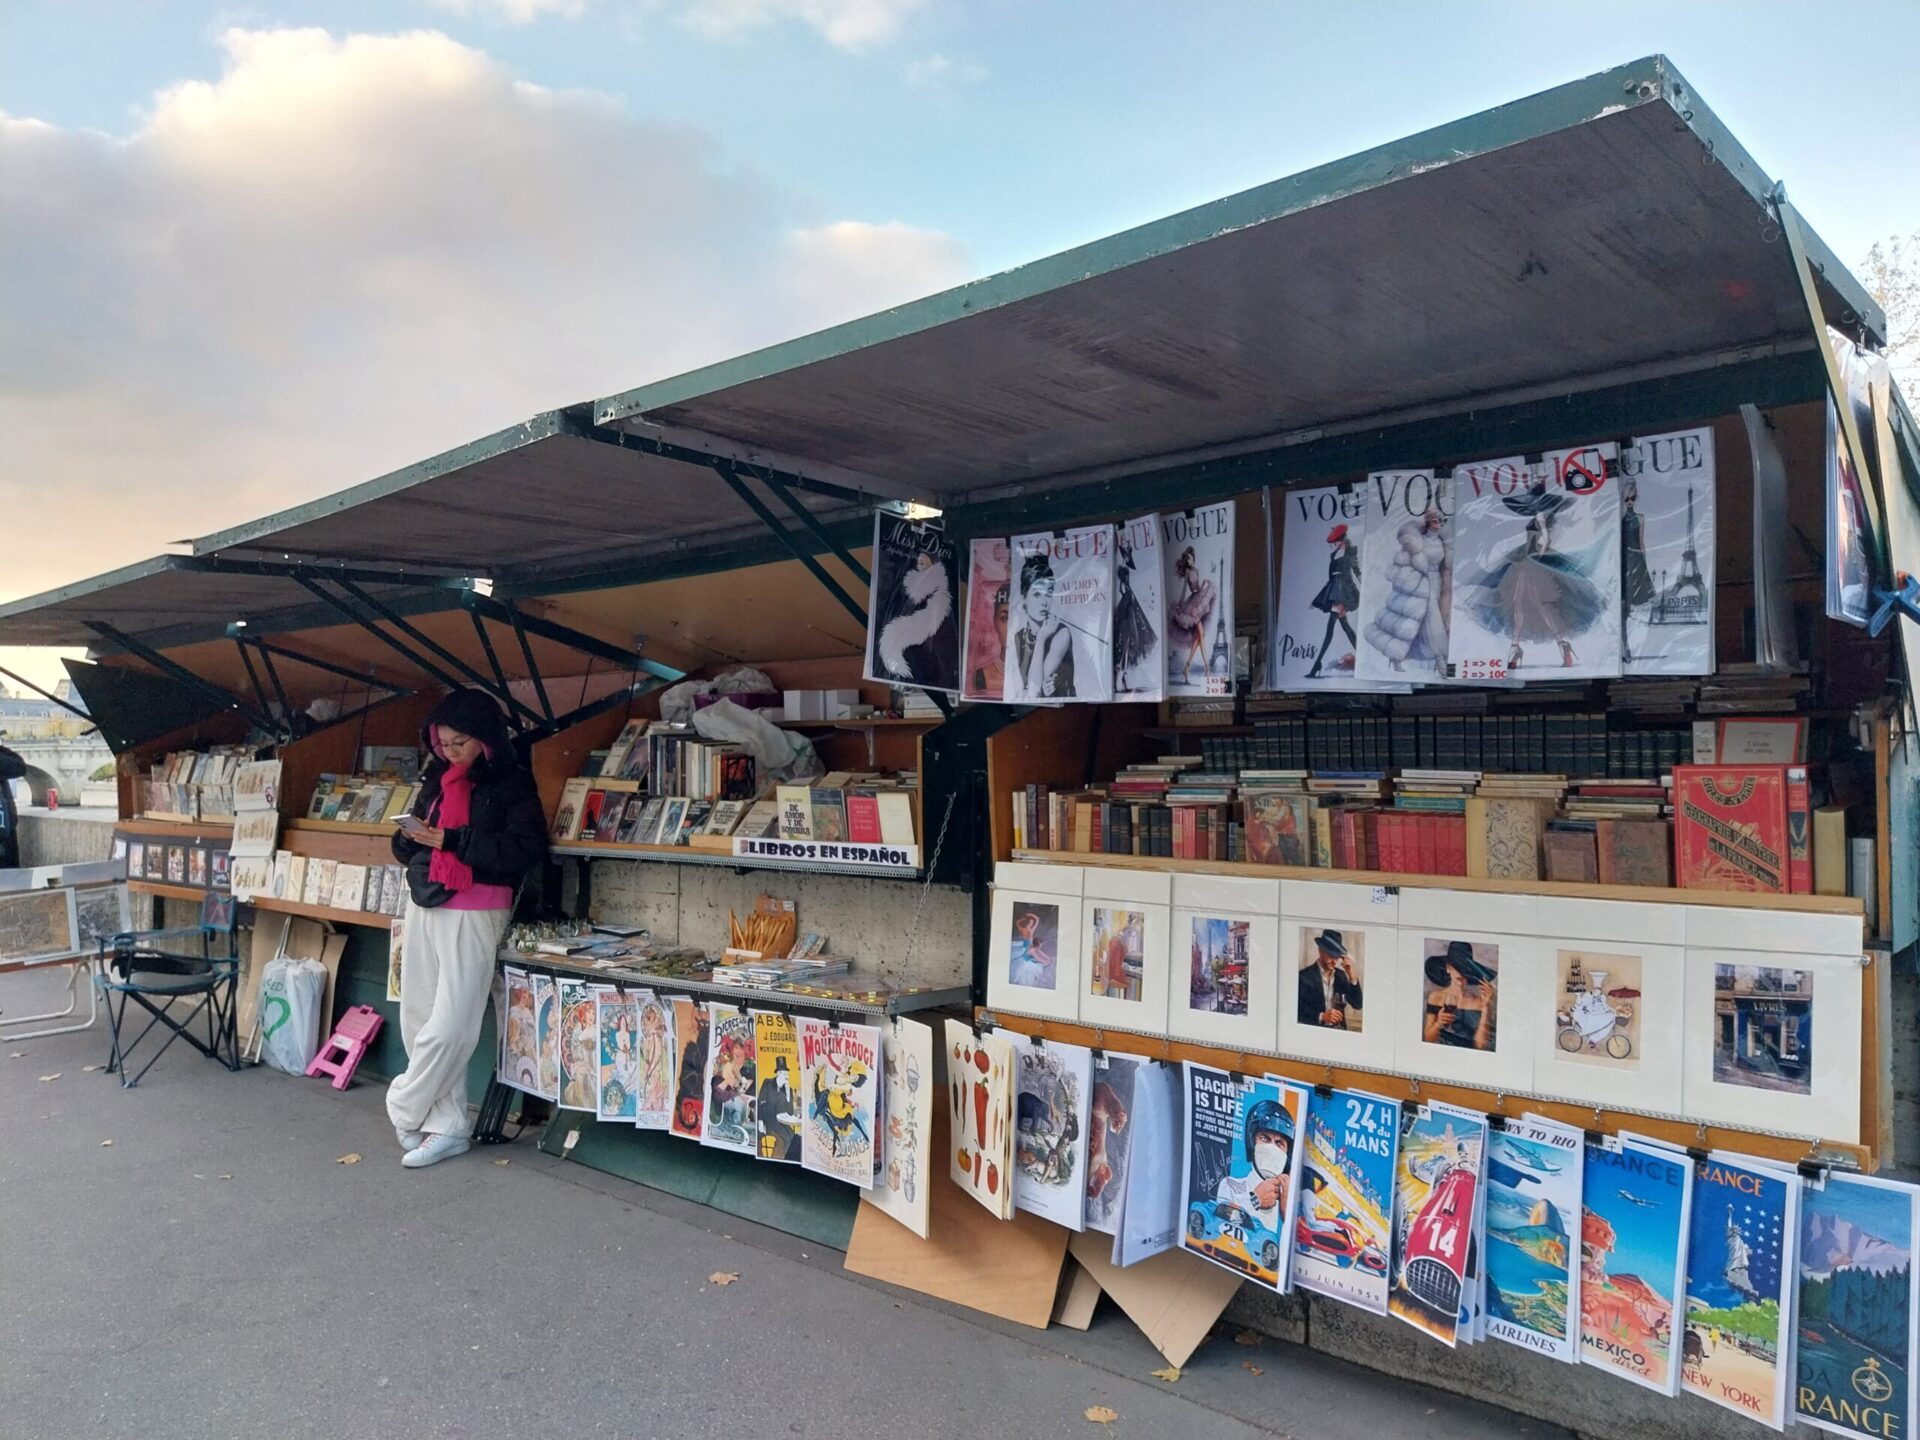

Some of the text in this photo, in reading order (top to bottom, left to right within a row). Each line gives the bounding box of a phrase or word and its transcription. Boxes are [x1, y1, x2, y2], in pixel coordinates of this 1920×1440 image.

[1163, 508, 1227, 543] VOGUE
[883, 521, 915, 549] Miss
[920, 531, 953, 559] Dior
[1279, 634, 1317, 666] Paris
[750, 842, 911, 866] LIBROS EN ESPAÑOL
[805, 1024, 858, 1039] AU JOEUX
[803, 1035, 874, 1071] MOULIN ROUGE
[1195, 1090, 1244, 1118] IS LIFE
[1346, 1099, 1391, 1133] 24 H
[1195, 1113, 1244, 1132] BEFORE OR AFTER
[1203, 1122, 1218, 1133] JUST
[1377, 1126, 1391, 1138] du
[1345, 1129, 1390, 1158] MANS
[1529, 1128, 1546, 1141] TO
[1551, 1134, 1577, 1149] RIO
[1223, 1223, 1243, 1242] 20
[1428, 1220, 1457, 1259] 14
[1317, 1274, 1344, 1289] JUIN
[1350, 1285, 1380, 1302] 1959
[1491, 1324, 1557, 1353] AIRLINES
[1581, 1333, 1646, 1366] MEXICO
[1611, 1356, 1652, 1377] direct
[1681, 1367, 1762, 1413] NEW YORK
